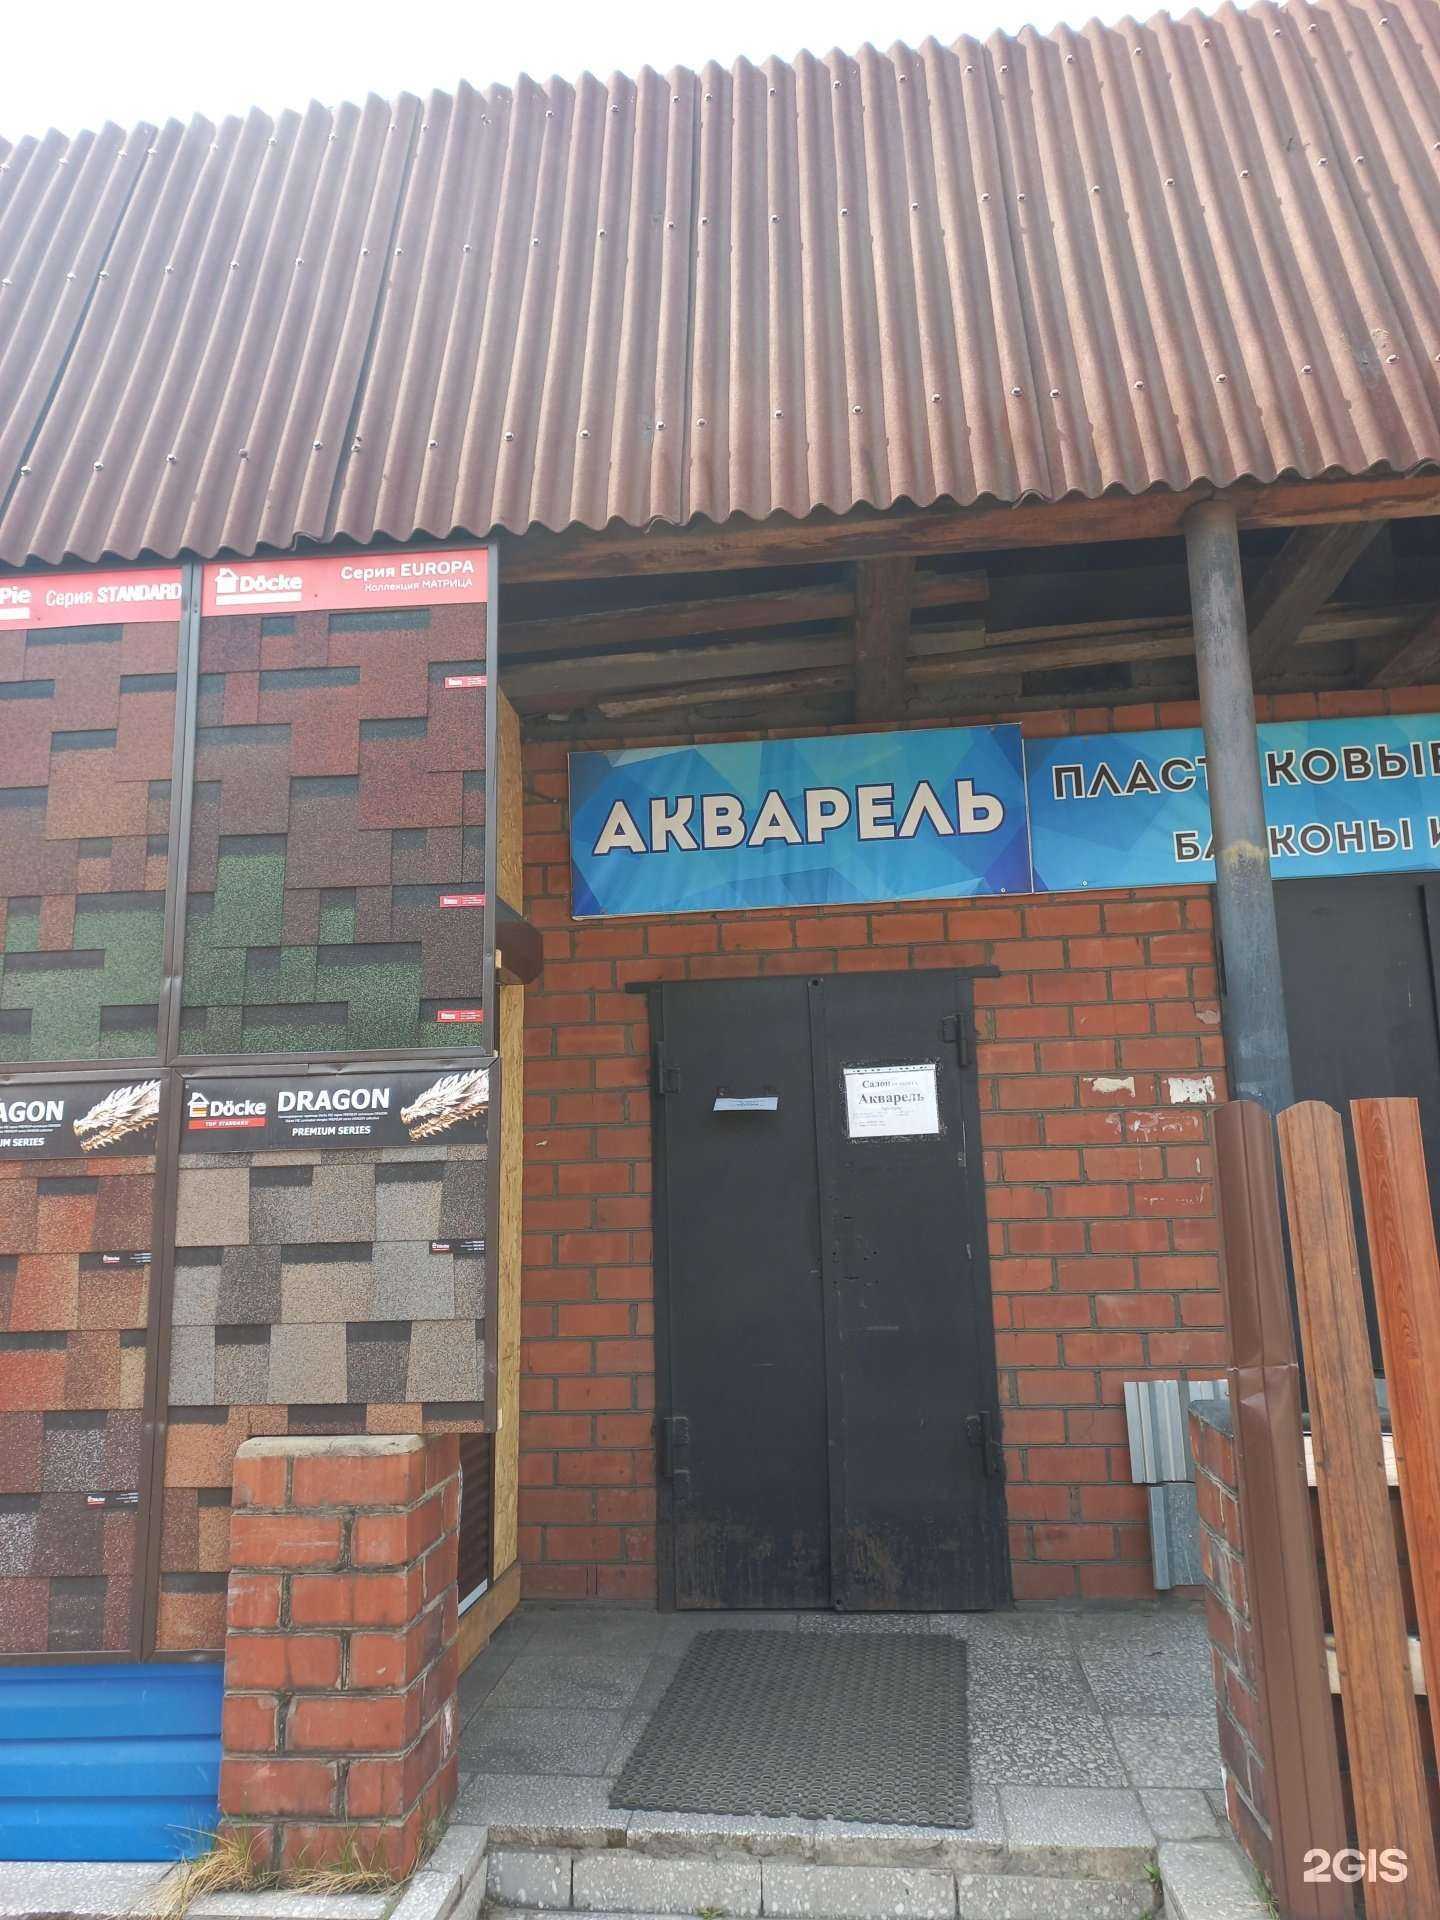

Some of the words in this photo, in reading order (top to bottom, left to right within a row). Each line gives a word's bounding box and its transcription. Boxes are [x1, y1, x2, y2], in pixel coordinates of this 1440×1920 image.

[340, 565, 397, 581] Серия
[400, 560, 474, 577] EUROPA
[364, 582, 419, 592] Коллекция
[422, 578, 473, 589] МАТРИЦА
[46, 589, 93, 608] Серия
[97, 582, 183, 603] STANDARD
[592, 778, 1005, 857] АКВАРЕЛЬ
[1173, 817, 1413, 863] БКОНЫ
[210, 1099, 267, 1117] Döcke
[277, 1088, 390, 1112] DRAGON
[858, 1093, 925, 1105] Акварель
[292, 1127, 336, 1137] PREMIUM
[338, 1125, 371, 1135] SERIES
[12, 1137, 46, 1147] SERIES
